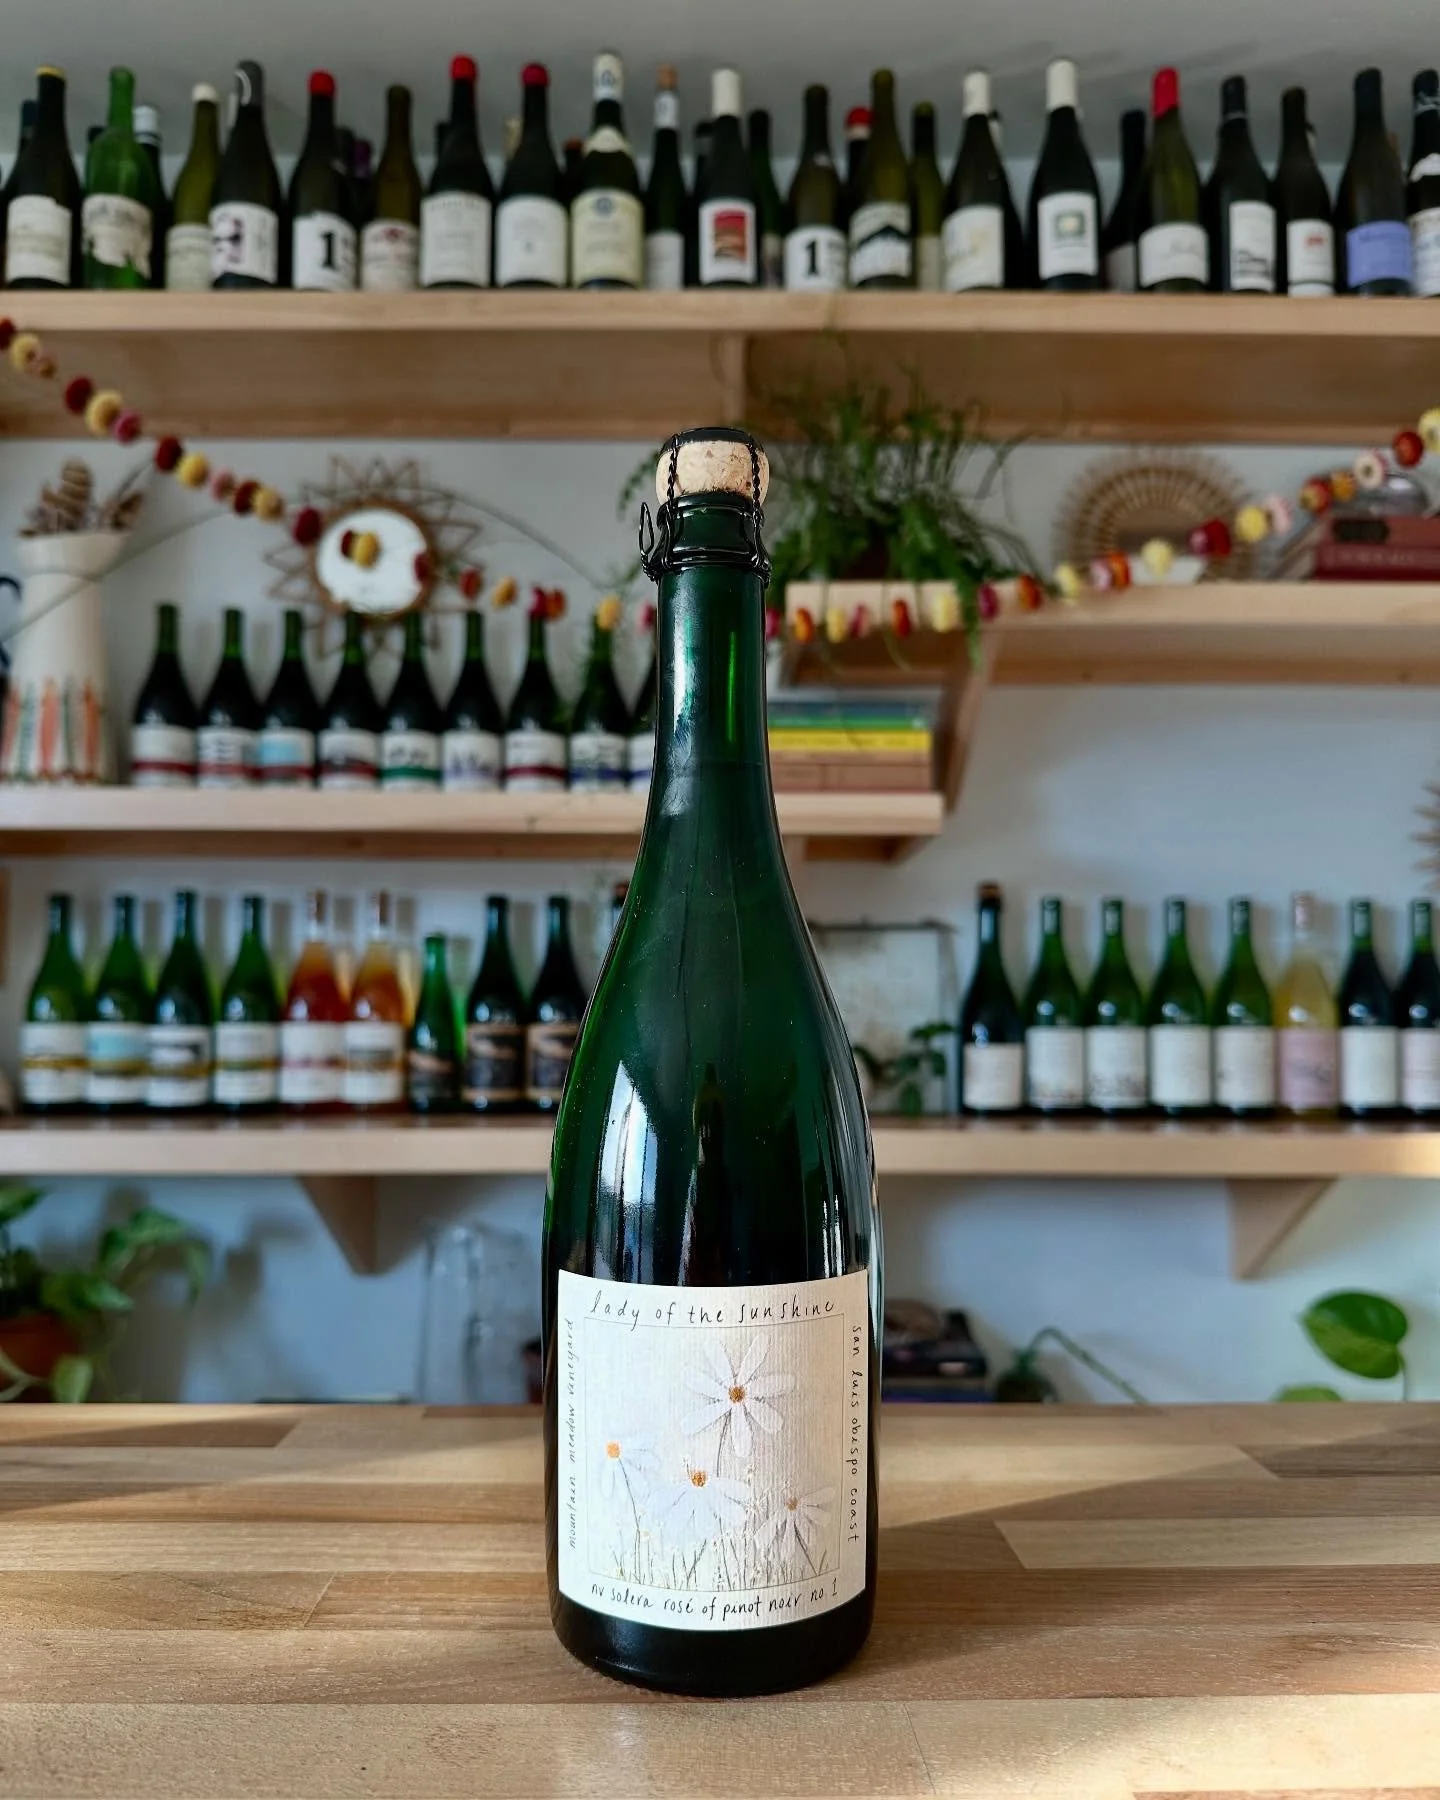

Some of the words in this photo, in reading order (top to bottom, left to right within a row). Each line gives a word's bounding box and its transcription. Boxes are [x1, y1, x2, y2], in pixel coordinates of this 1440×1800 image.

[320, 231, 340, 272] 1
[804, 240, 820, 277] 1
[589, 1290, 640, 1332] lady
[655, 1302, 677, 1325] of
[688, 1307, 724, 1324] the
[738, 1294, 835, 1324] sunshine
[564, 1318, 580, 1396] vineyard
[851, 1325, 862, 1356] san
[851, 1371, 864, 1408] luis
[565, 1403, 577, 1463] meadow
[845, 1416, 862, 1475] obispo
[566, 1475, 577, 1550] mountain
[847, 1487, 861, 1543] coast
[591, 1583, 606, 1598] nv
[610, 1587, 655, 1608] solera
[663, 1599, 694, 1614] rosé
[702, 1596, 716, 1622] of
[723, 1594, 763, 1622] pinot
[768, 1594, 801, 1613] noir
[810, 1588, 825, 1602] no
[831, 1576, 839, 1597] 1
